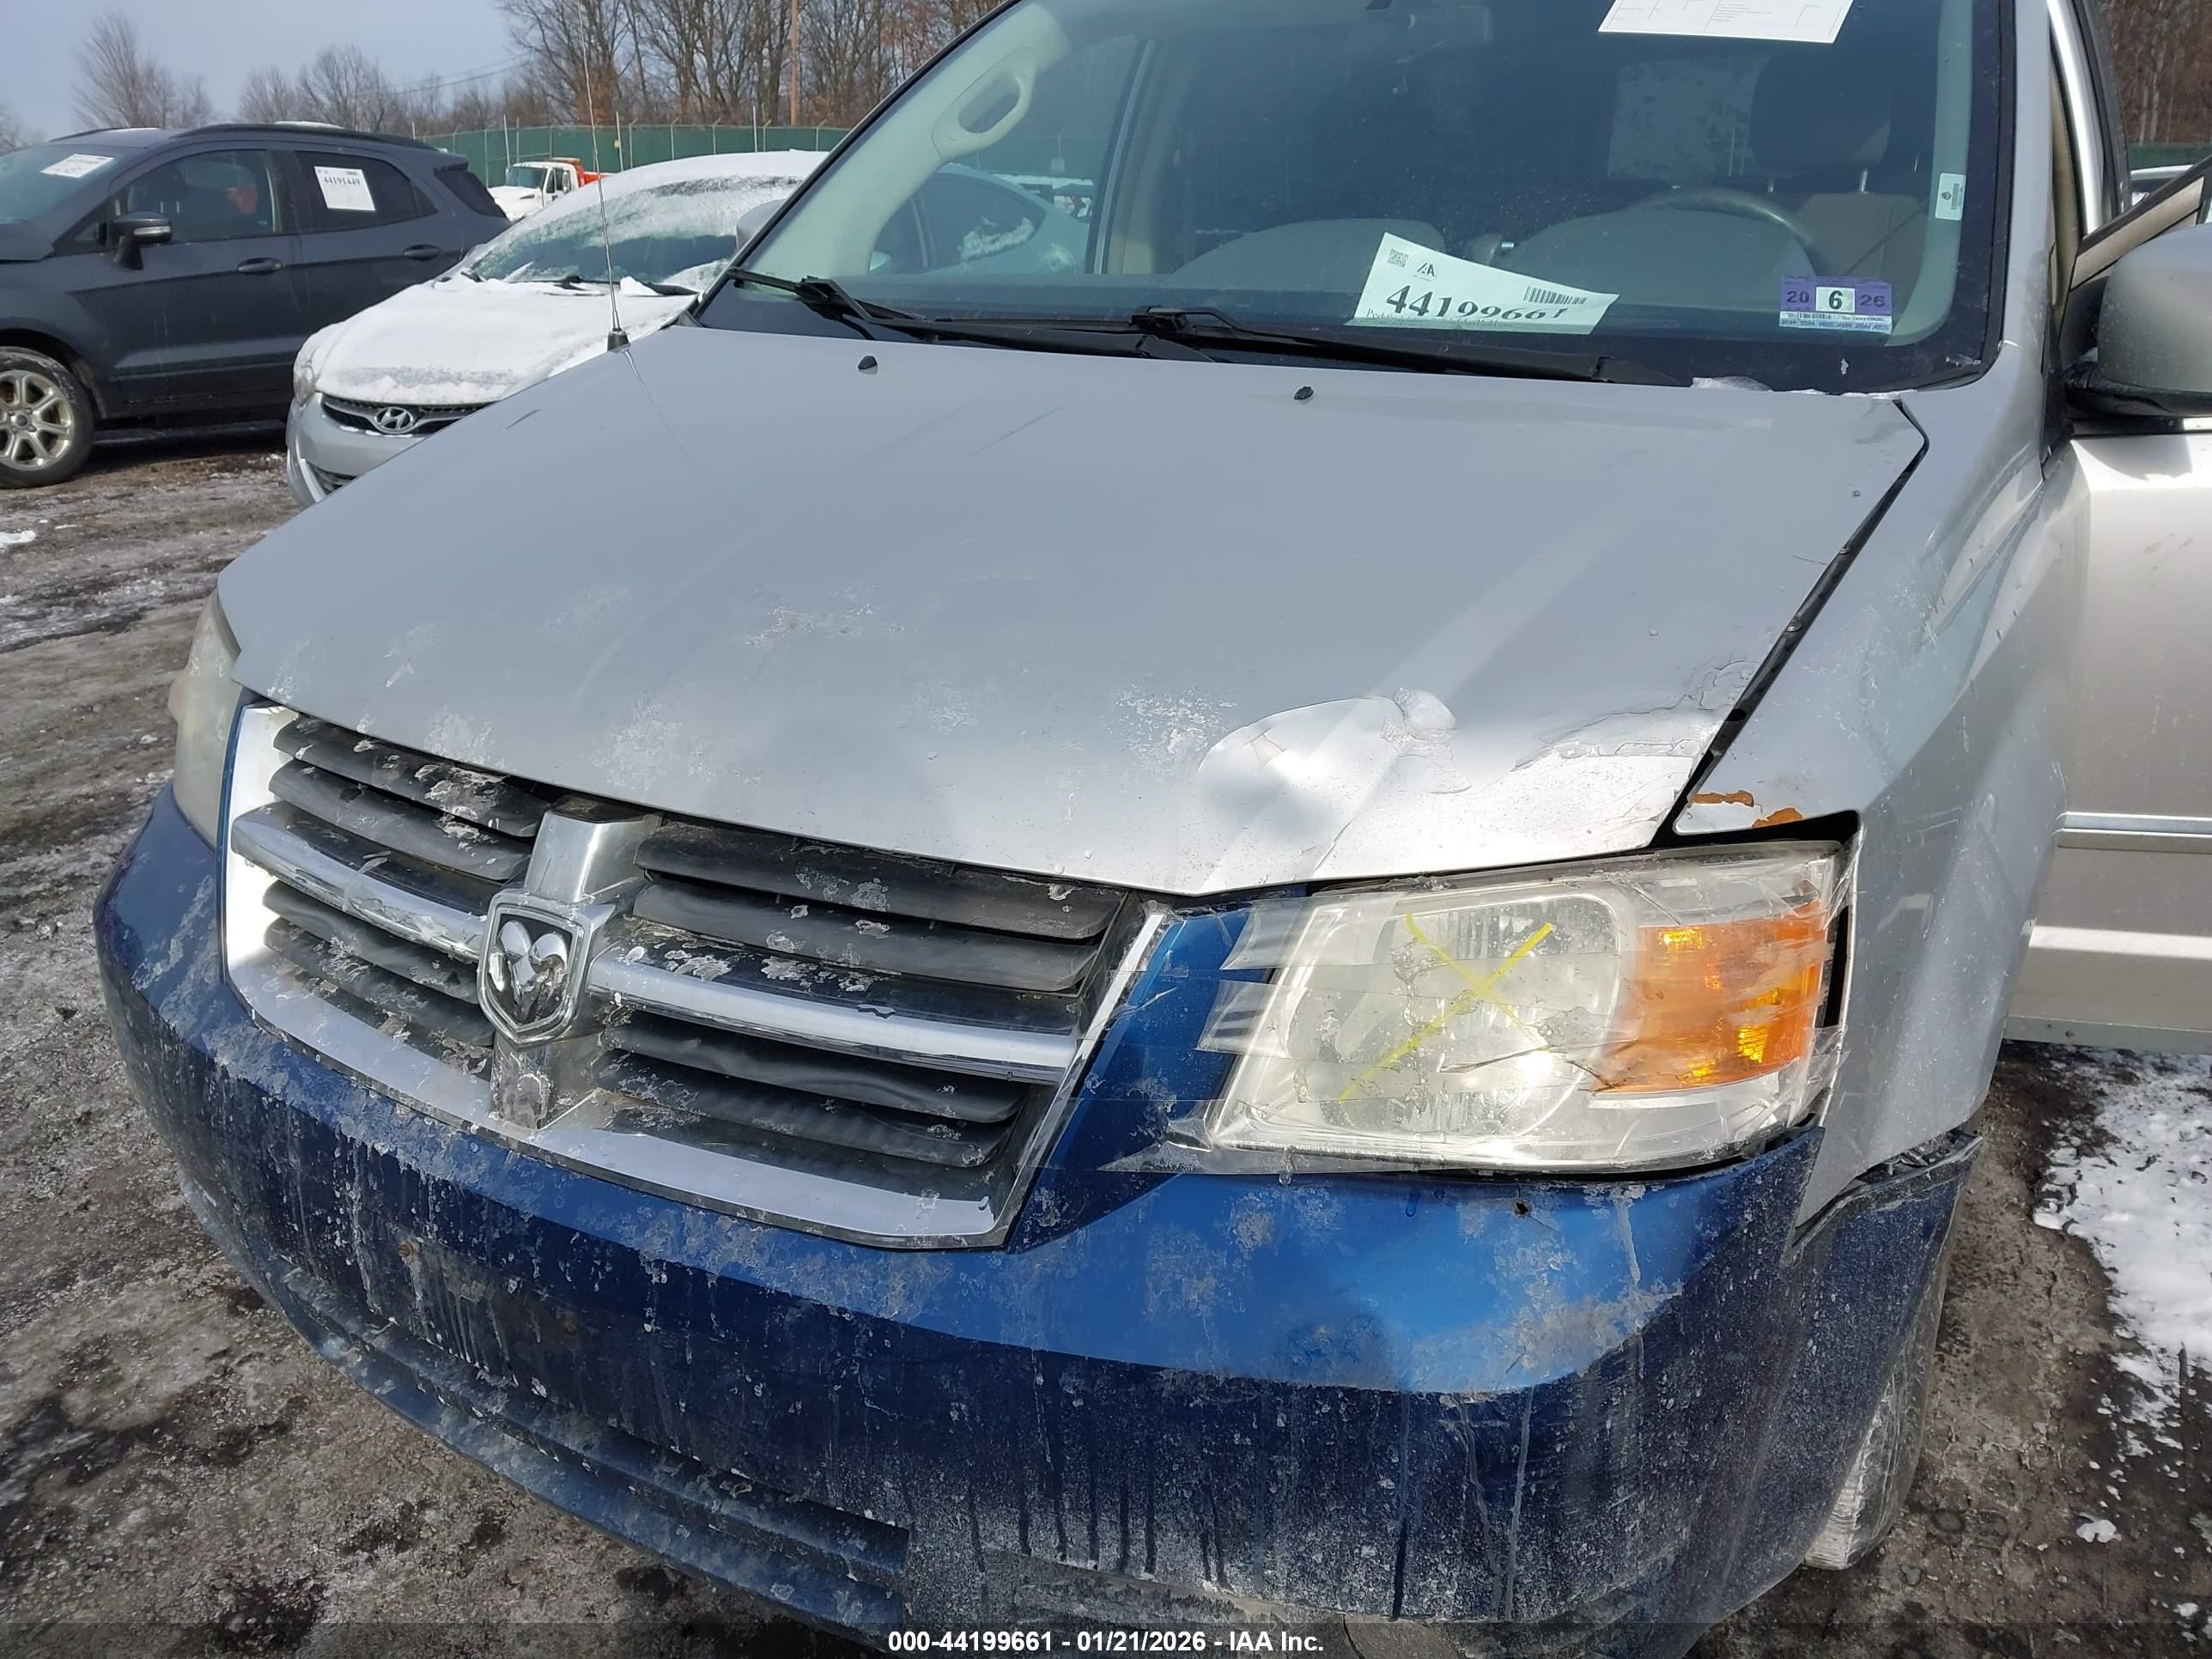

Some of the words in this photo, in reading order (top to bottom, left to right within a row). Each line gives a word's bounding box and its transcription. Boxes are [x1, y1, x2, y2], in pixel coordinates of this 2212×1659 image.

[1786, 290, 1810, 303] 20
[1828, 289, 1844, 310] 6
[1860, 295, 1886, 307] 26
